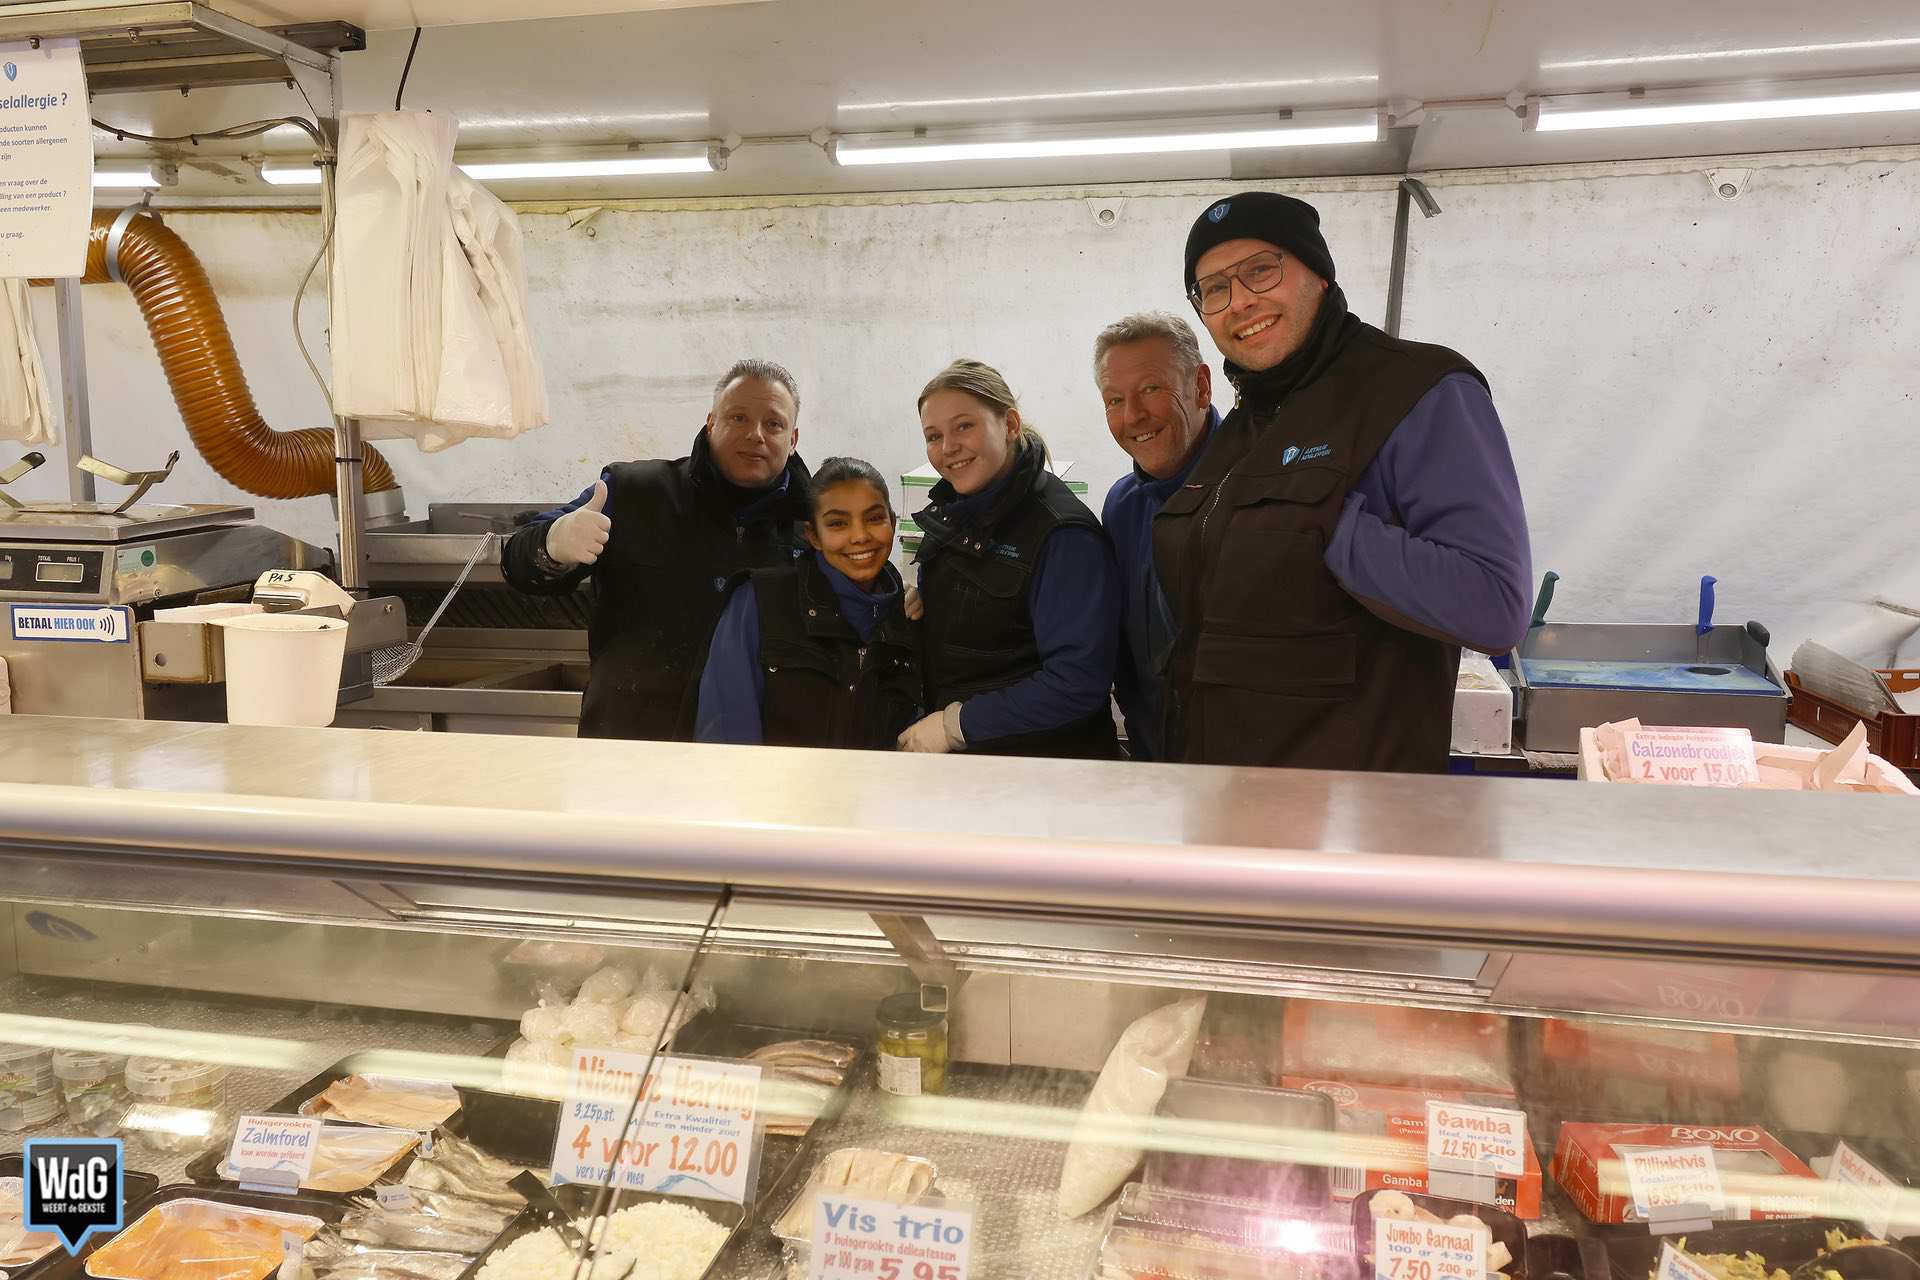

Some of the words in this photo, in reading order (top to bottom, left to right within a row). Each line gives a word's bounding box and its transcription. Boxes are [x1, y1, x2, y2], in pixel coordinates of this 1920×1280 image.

[61, 92, 68, 105] ?
[24, 123, 48, 131] kunnen
[35, 137, 68, 146] allergenen
[8, 179, 24, 187] vraag
[25, 178, 39, 186] over
[40, 177, 48, 185] de
[38, 190, 61, 199] product
[268, 572, 296, 583] PAS
[18, 616, 53, 630] BETAAL
[54, 617, 75, 630] HIER
[75, 617, 96, 631] OOK
[1642, 760, 1655, 779] 2
[1659, 766, 1697, 780] voor
[1437, 1109, 1513, 1135] Gamba
[240, 1126, 312, 1149] Zalmforel
[1671, 1127, 1760, 1142] BONO
[571, 1123, 593, 1160] 4
[602, 1136, 661, 1168] voor
[669, 1134, 739, 1178] 12.00
[1441, 1138, 1478, 1160] 22.50
[1480, 1142, 1517, 1157] Kilo
[575, 1164, 595, 1179] vers
[1382, 1173, 1423, 1188] Gamba
[822, 1201, 877, 1234] Vis
[892, 1214, 965, 1245] trio
[834, 1232, 895, 1252] huisgerookte
[1386, 1222, 1423, 1246] Jumbo
[1426, 1228, 1474, 1253] Garnaal
[1387, 1243, 1413, 1254] 100
[838, 1250, 853, 1269] 100
[854, 1256, 875, 1274] gram
[1389, 1257, 1432, 1280] 7.50
[1438, 1262, 1461, 1274] 200
